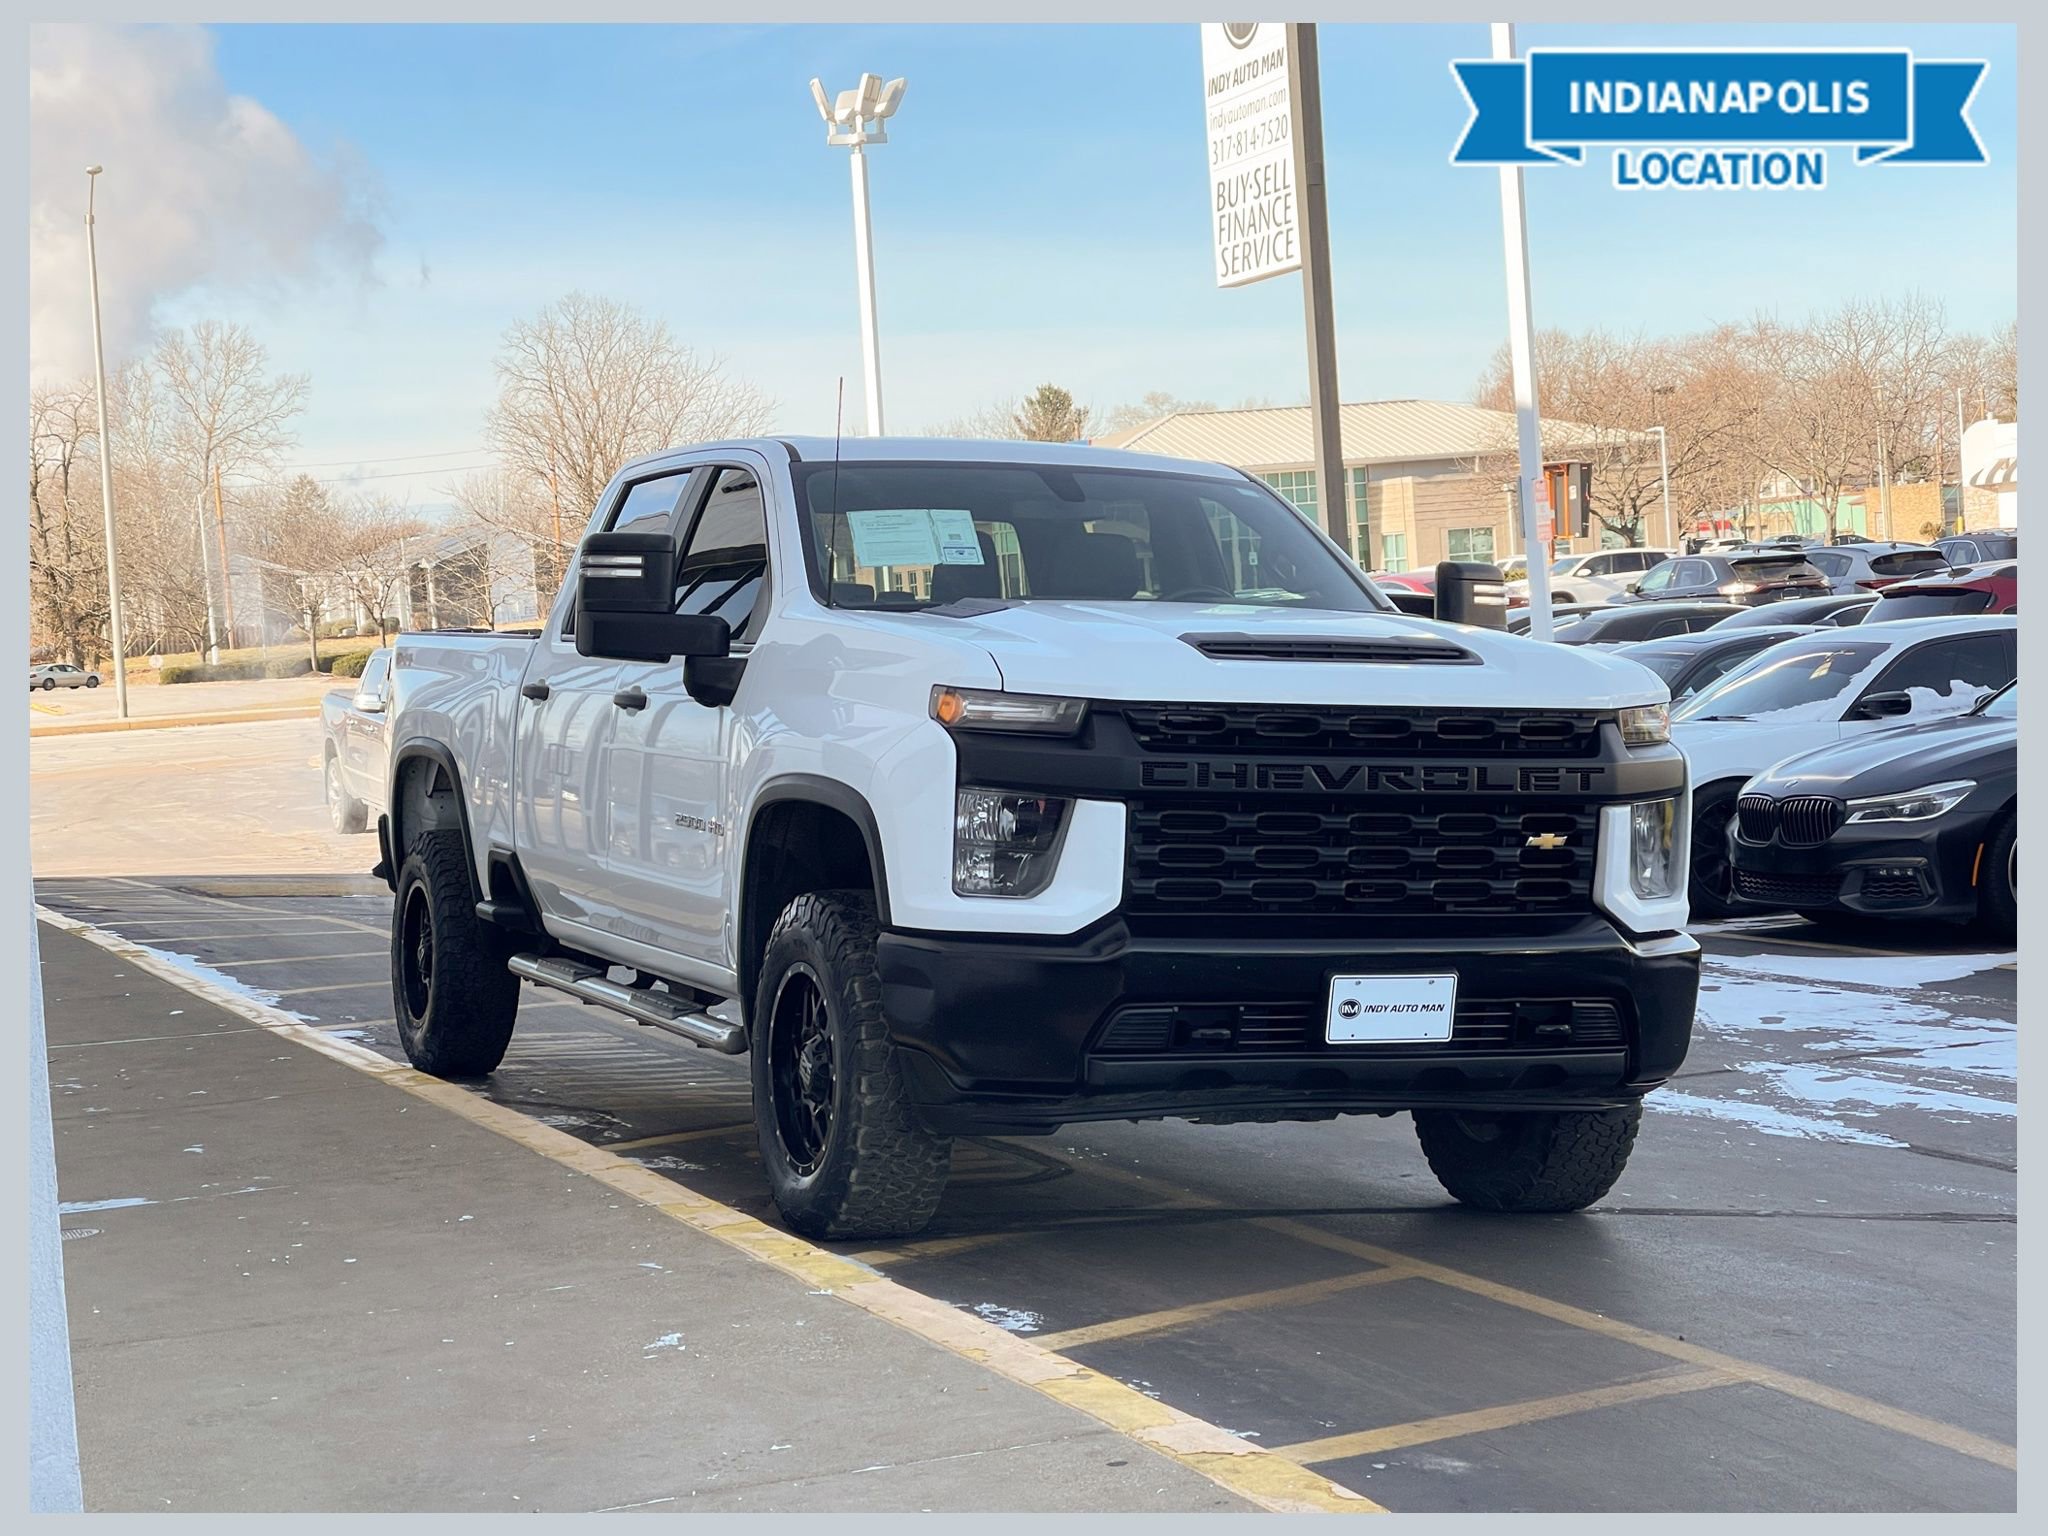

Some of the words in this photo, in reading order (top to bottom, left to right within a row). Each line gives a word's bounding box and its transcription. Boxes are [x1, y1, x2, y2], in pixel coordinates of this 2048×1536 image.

[1207, 71, 1231, 97] INDY
[1232, 58, 1259, 86] AUTO
[1261, 47, 1285, 74] MAN
[1209, 87, 1287, 132] indyautoman.com
[1218, 192, 1292, 245] FINANCE
[1220, 227, 1294, 278] SERVICE
[1140, 760, 1606, 793] CHEVROLET
[674, 813, 706, 831] 2500
[1364, 1004, 1388, 1014] INDY
[1390, 1003, 1419, 1013] AUTO
[1420, 1003, 1445, 1013] MAN
